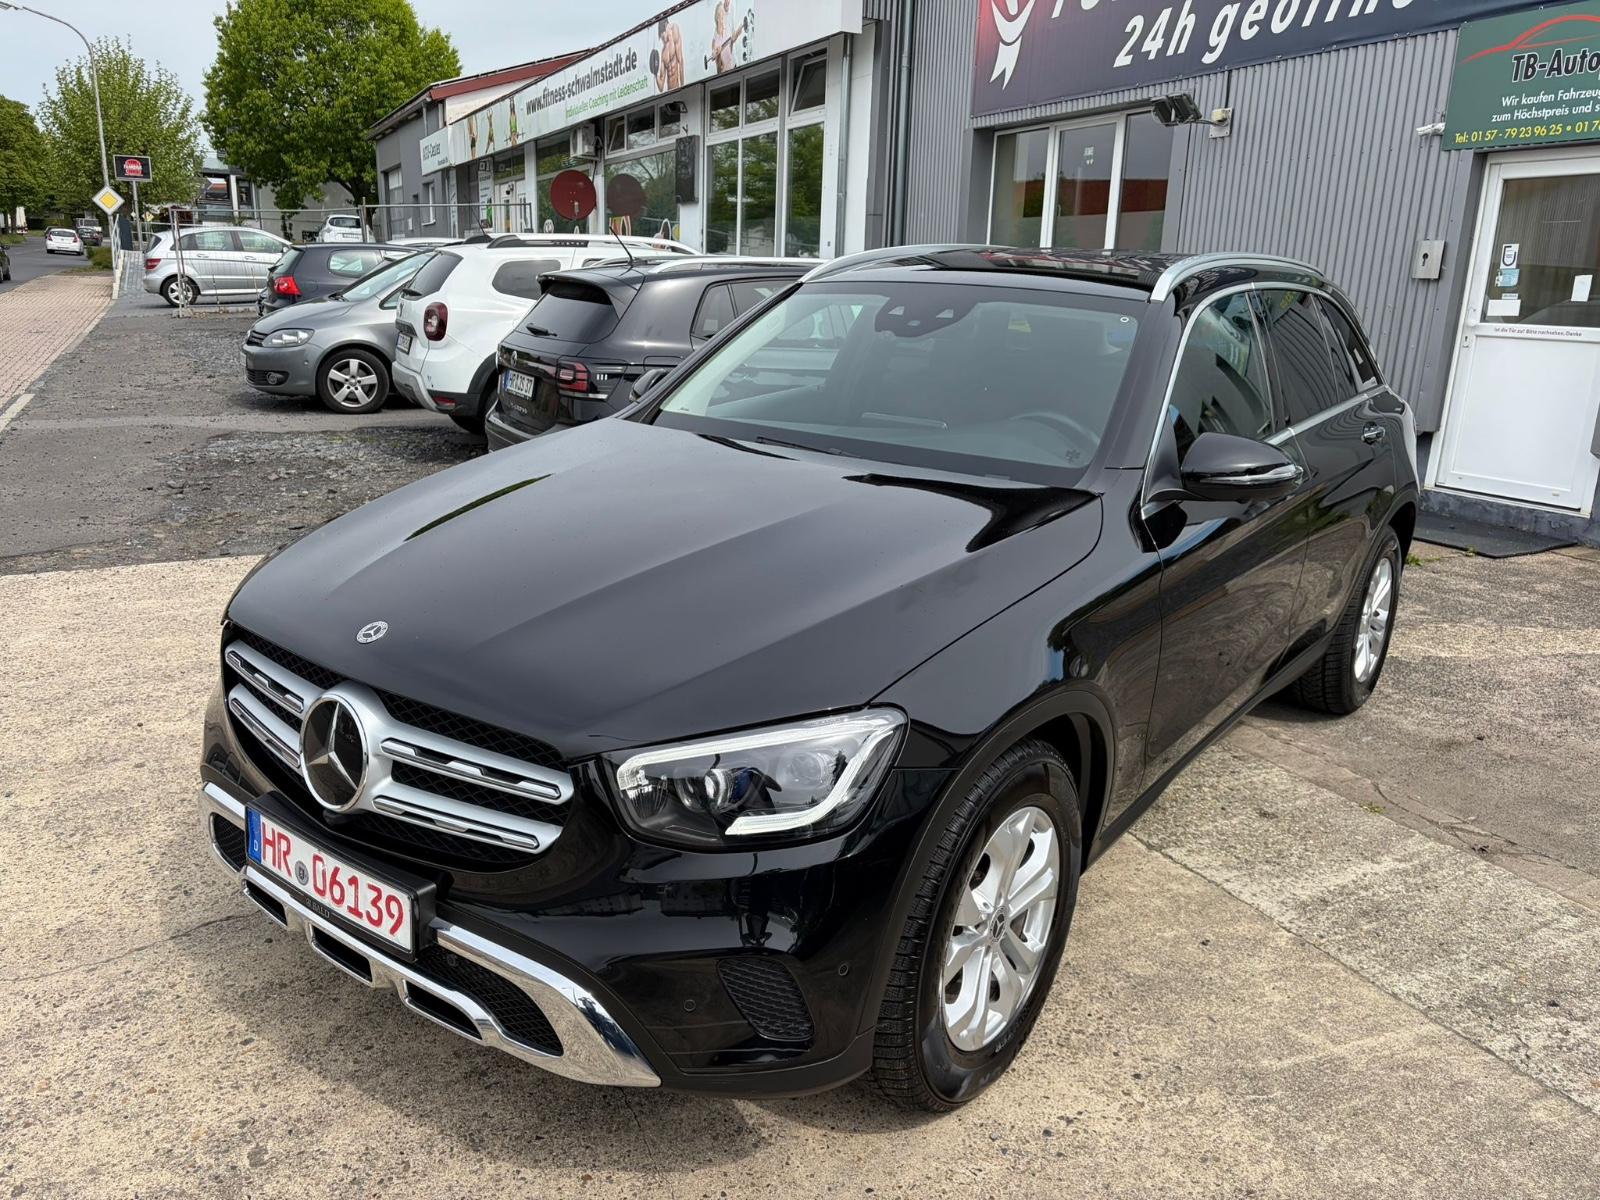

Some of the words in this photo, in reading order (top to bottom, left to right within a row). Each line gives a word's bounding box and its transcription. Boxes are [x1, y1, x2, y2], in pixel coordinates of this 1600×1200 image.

[1113, 0, 1196, 68] 24h
[526, 47, 637, 115] www.fitness-schwalmstadt.de
[1502, 97, 1519, 107] Wir
[1521, 91, 1554, 105] kaufen
[1558, 87, 1600, 101] Fahrzeu
[1491, 112, 1511, 122] zum
[1513, 104, 1569, 120] Höchstpreis
[1572, 101, 1593, 114] und
[1455, 131, 1469, 143] Tel:
[254, 839, 259, 851] D
[262, 822, 293, 877] HR
[312, 853, 404, 936] 06139
